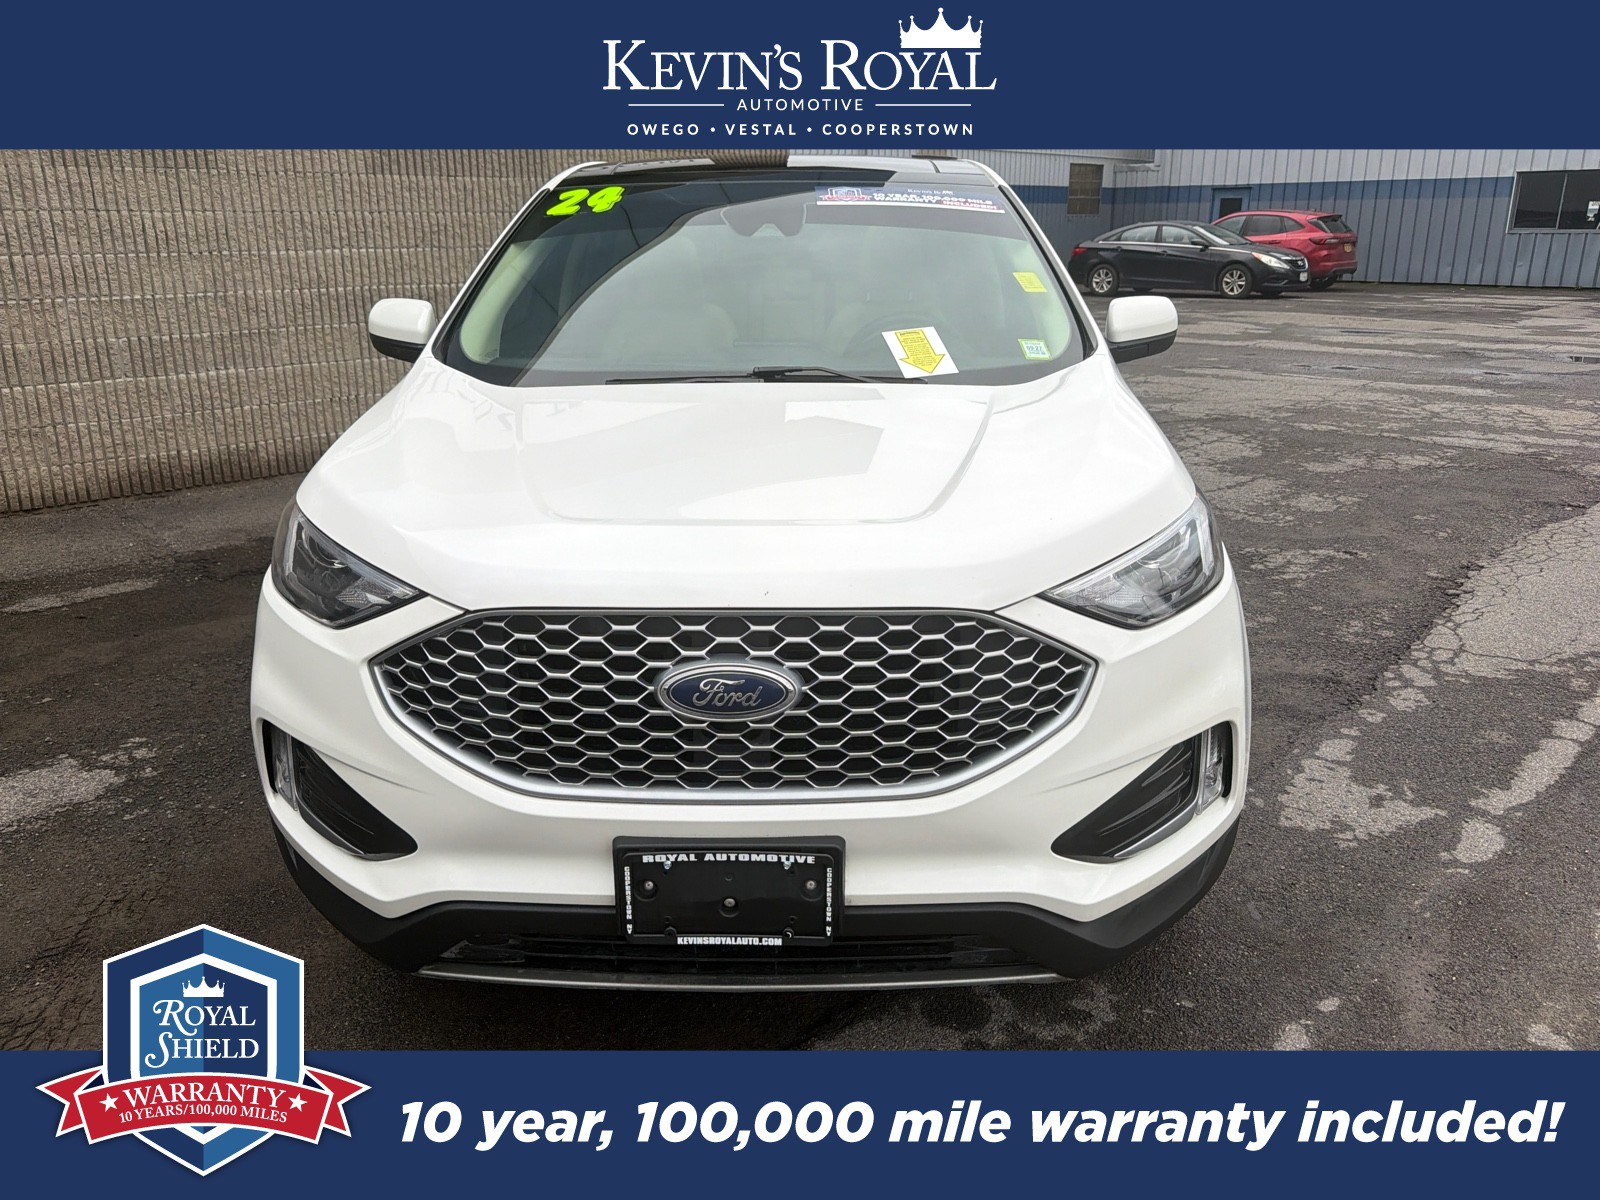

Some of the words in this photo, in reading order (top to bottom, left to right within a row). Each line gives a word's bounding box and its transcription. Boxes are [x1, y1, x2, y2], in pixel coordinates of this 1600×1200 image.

[546, 186, 625, 216] 24
[692, 678, 764, 707] Ford
[642, 853, 698, 864] ROYAL
[703, 852, 816, 865] AUTOMOTIVE
[677, 936, 783, 947] KEVINSROYALAUTO.COM
